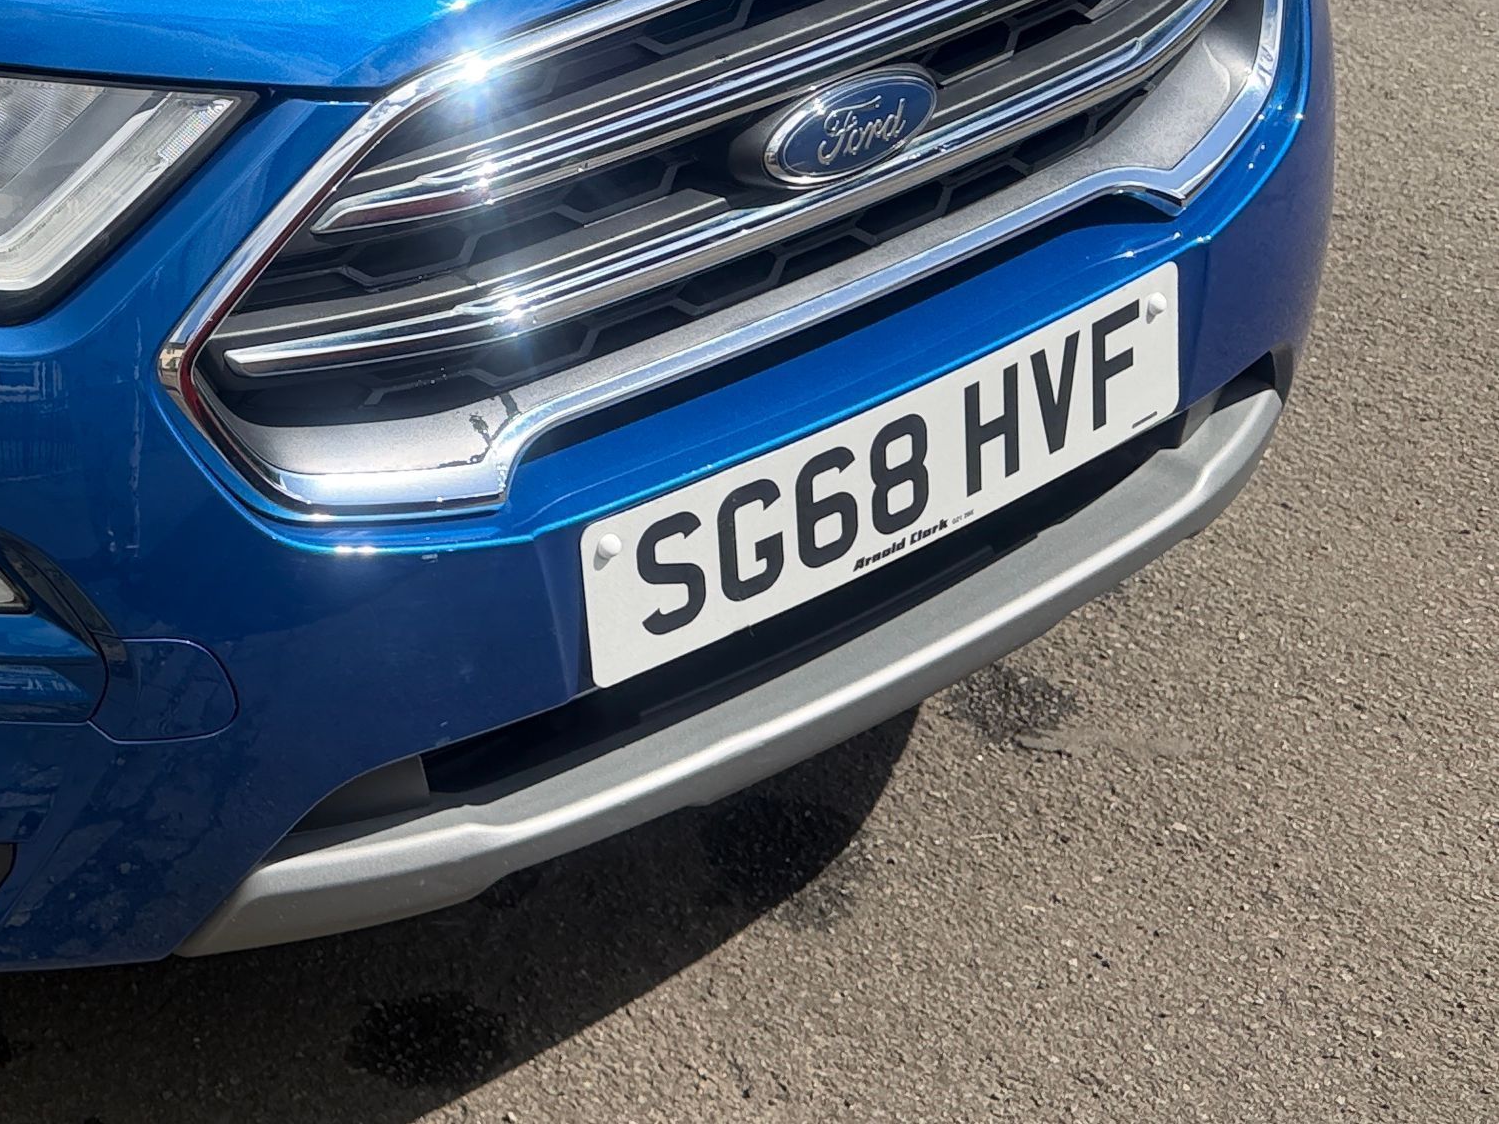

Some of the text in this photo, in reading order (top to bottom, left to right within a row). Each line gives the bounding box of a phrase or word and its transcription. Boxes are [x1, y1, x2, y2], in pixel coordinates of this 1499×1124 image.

[817, 95, 907, 165] Ford
[636, 298, 1141, 636] SG68 HVF
[853, 518, 949, 572] Arnold Clark
